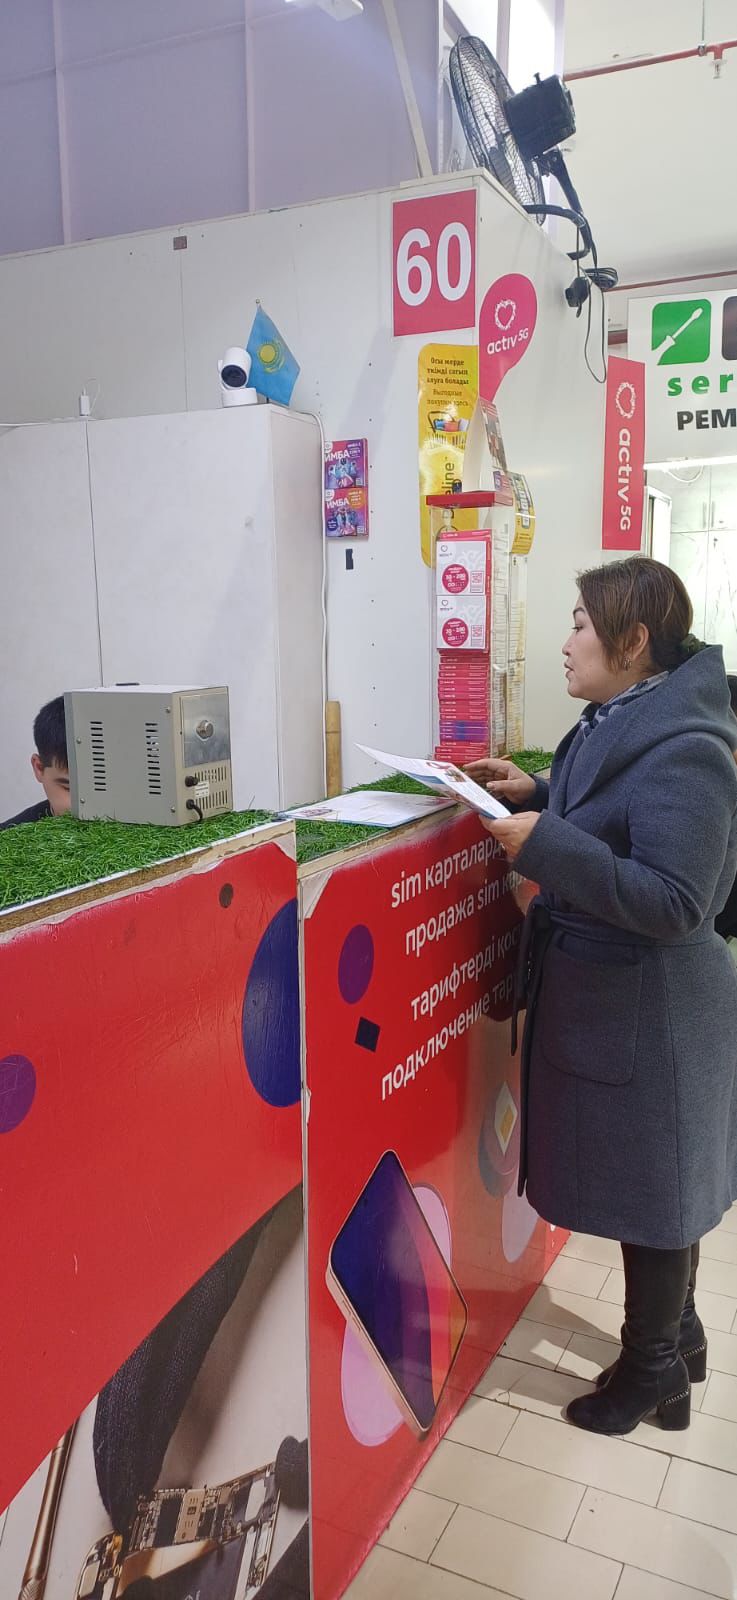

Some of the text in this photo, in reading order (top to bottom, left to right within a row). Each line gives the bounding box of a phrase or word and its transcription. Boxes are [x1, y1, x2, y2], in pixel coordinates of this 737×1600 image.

[397, 222, 472, 306] 60
[487, 327, 529, 355] activ 5G
[667, 373, 734, 396] ser
[677, 408, 737, 431] РЕМ
[325, 449, 350, 462] ИМБА
[617, 428, 632, 531] activ 5G
[327, 497, 350, 509] ИМБА
[391, 870, 421, 908] sim
[406, 894, 474, 958] продажа
[478, 878, 499, 910] sim
[411, 936, 495, 1021] тарифтерді
[382, 992, 489, 1101] подключение
